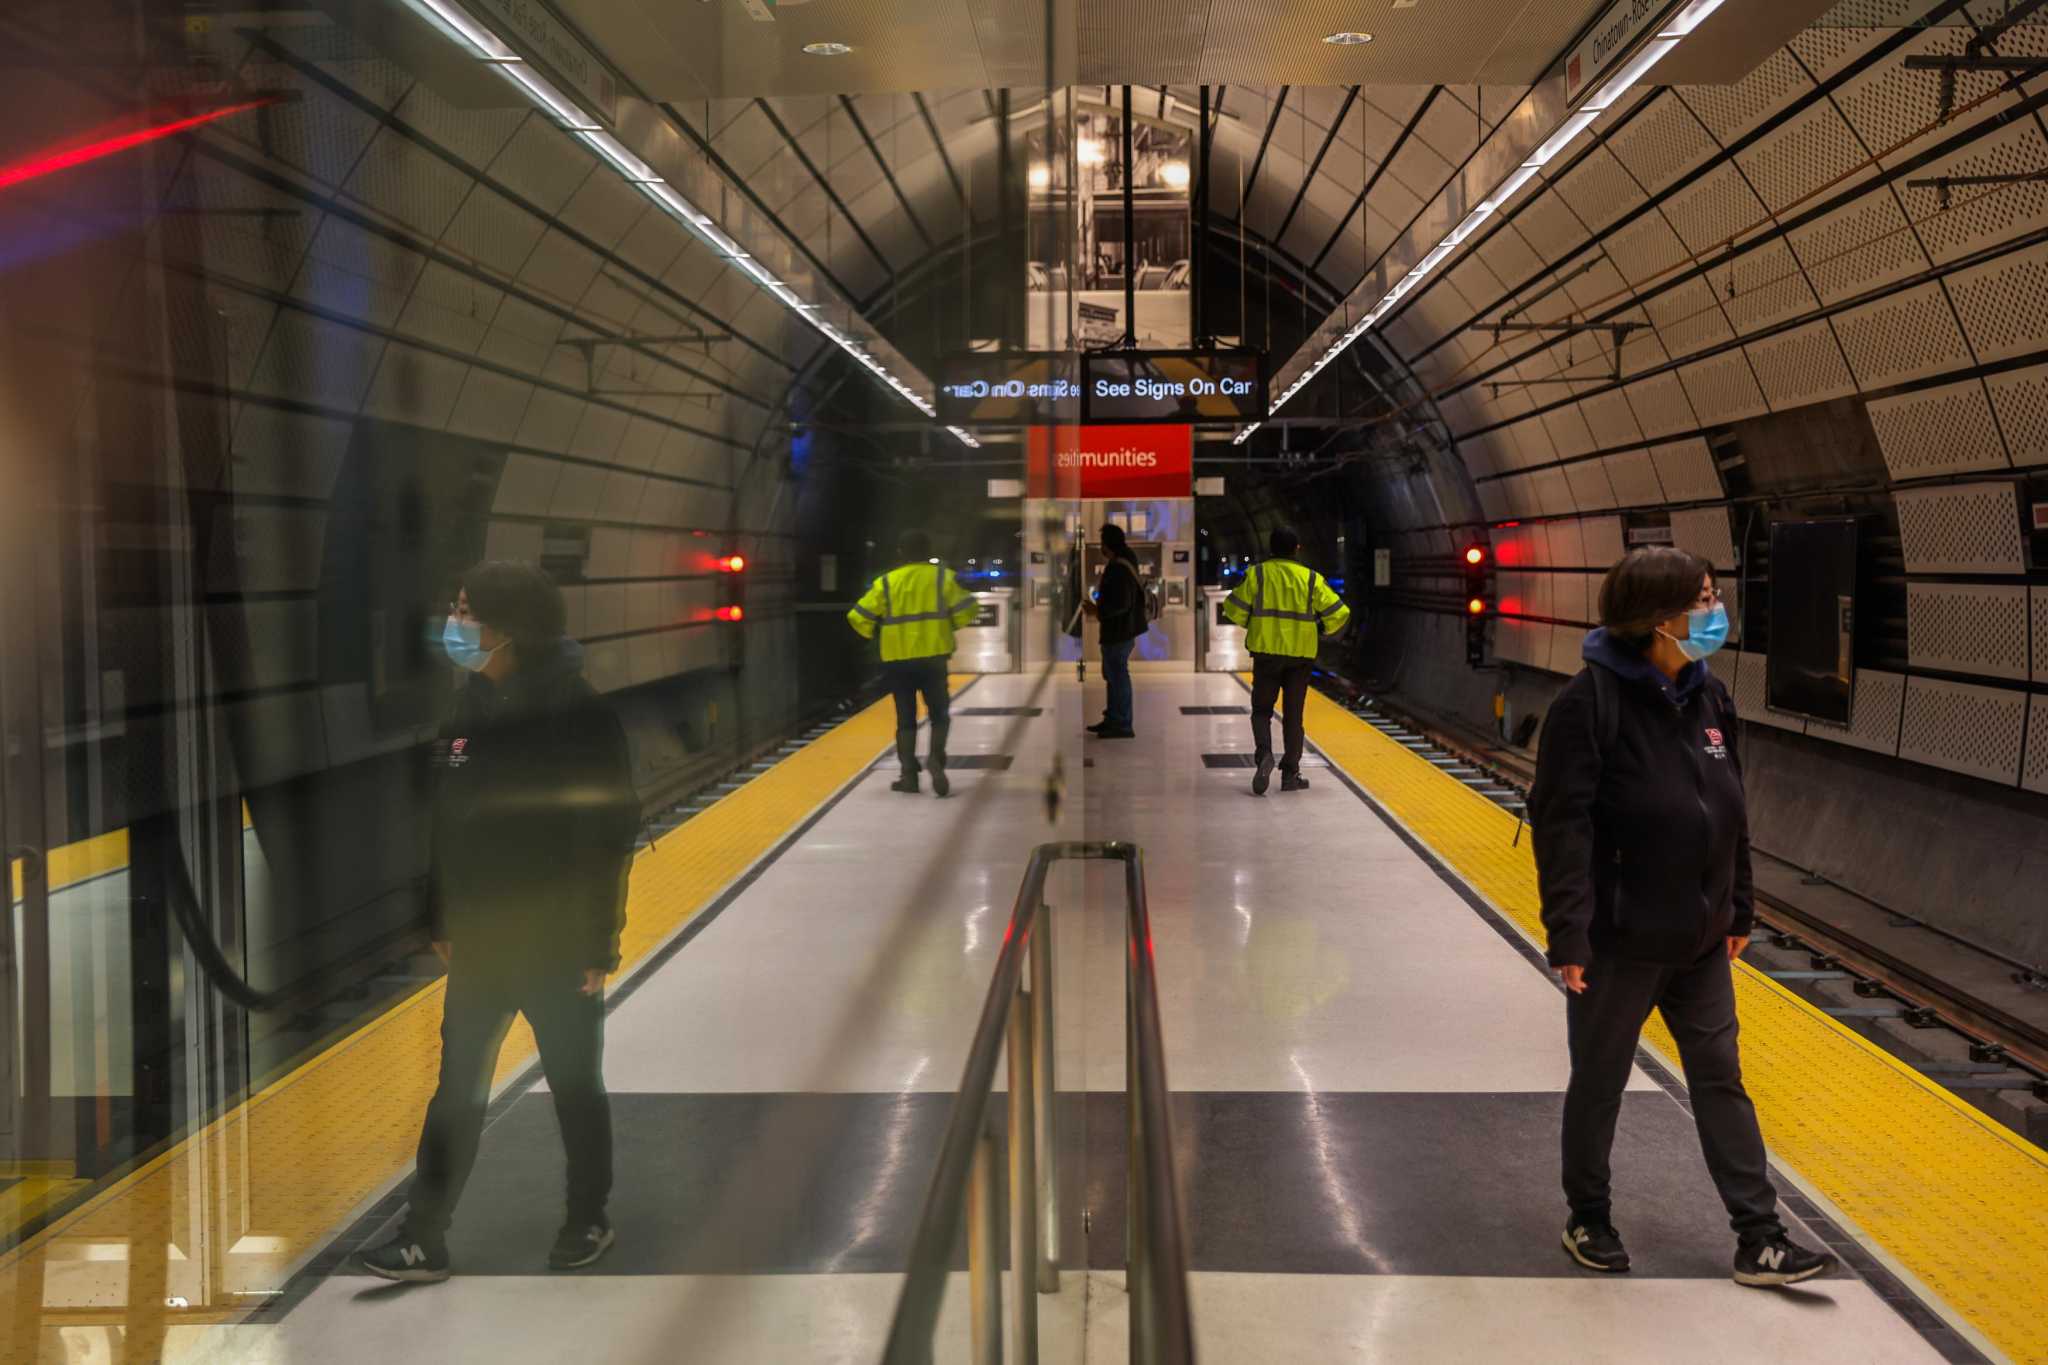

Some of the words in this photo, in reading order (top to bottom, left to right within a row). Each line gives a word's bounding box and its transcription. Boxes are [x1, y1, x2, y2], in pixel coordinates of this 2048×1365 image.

[1096, 380, 1130, 398] See
[1135, 378, 1185, 400] Signs
[1189, 378, 1215, 396] On
[1220, 377, 1252, 395] Car
[1757, 1247, 1784, 1269] N
